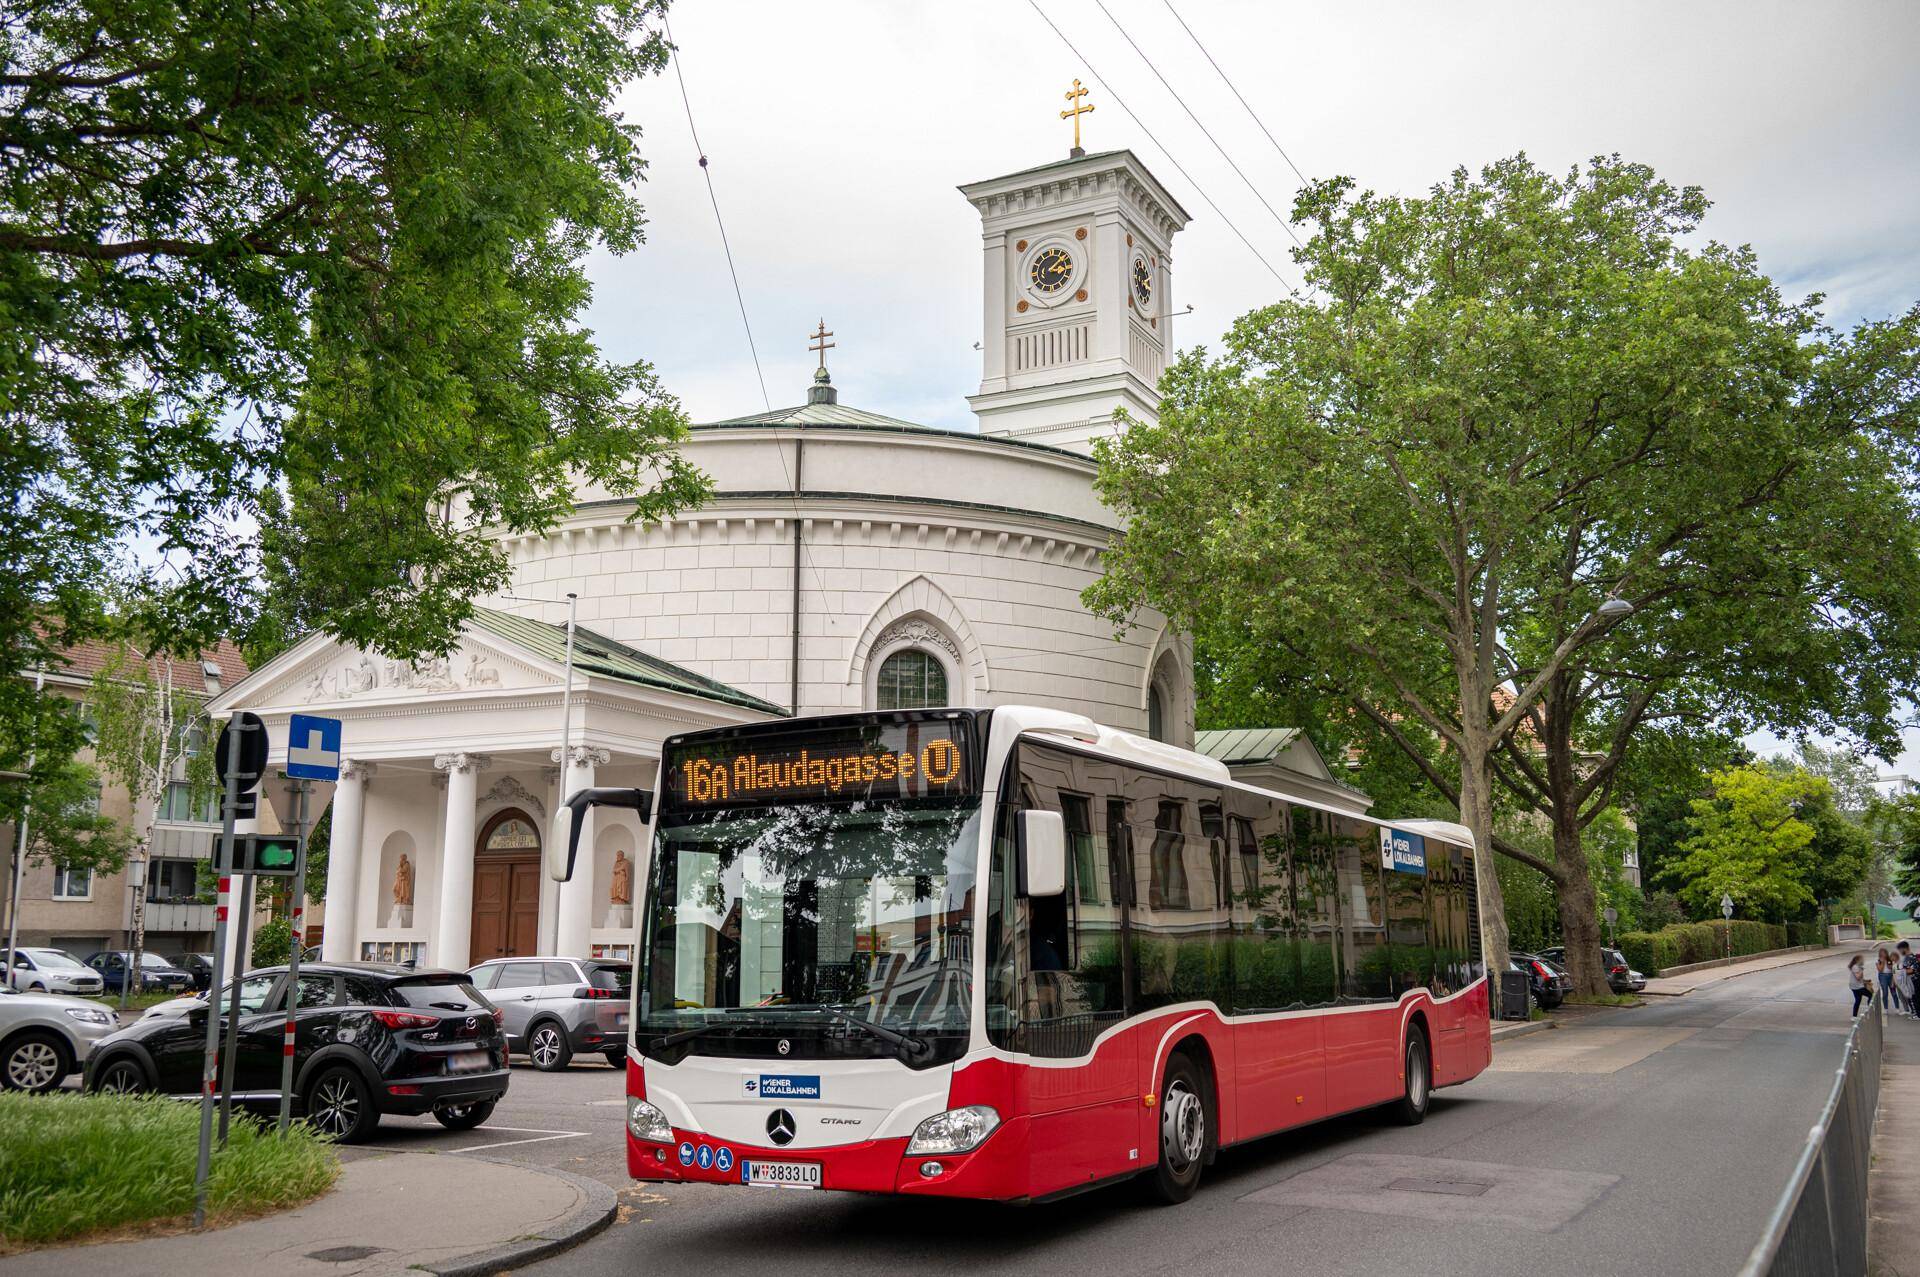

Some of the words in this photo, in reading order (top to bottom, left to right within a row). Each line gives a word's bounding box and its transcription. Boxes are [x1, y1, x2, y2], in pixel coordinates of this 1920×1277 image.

[683, 758, 728, 801] 16A
[734, 749, 916, 791] Alaudagasse
[762, 1079, 791, 1087] WIENER
[762, 1087, 817, 1095] LOKALBAHNEN
[820, 1117, 862, 1125] CITARO
